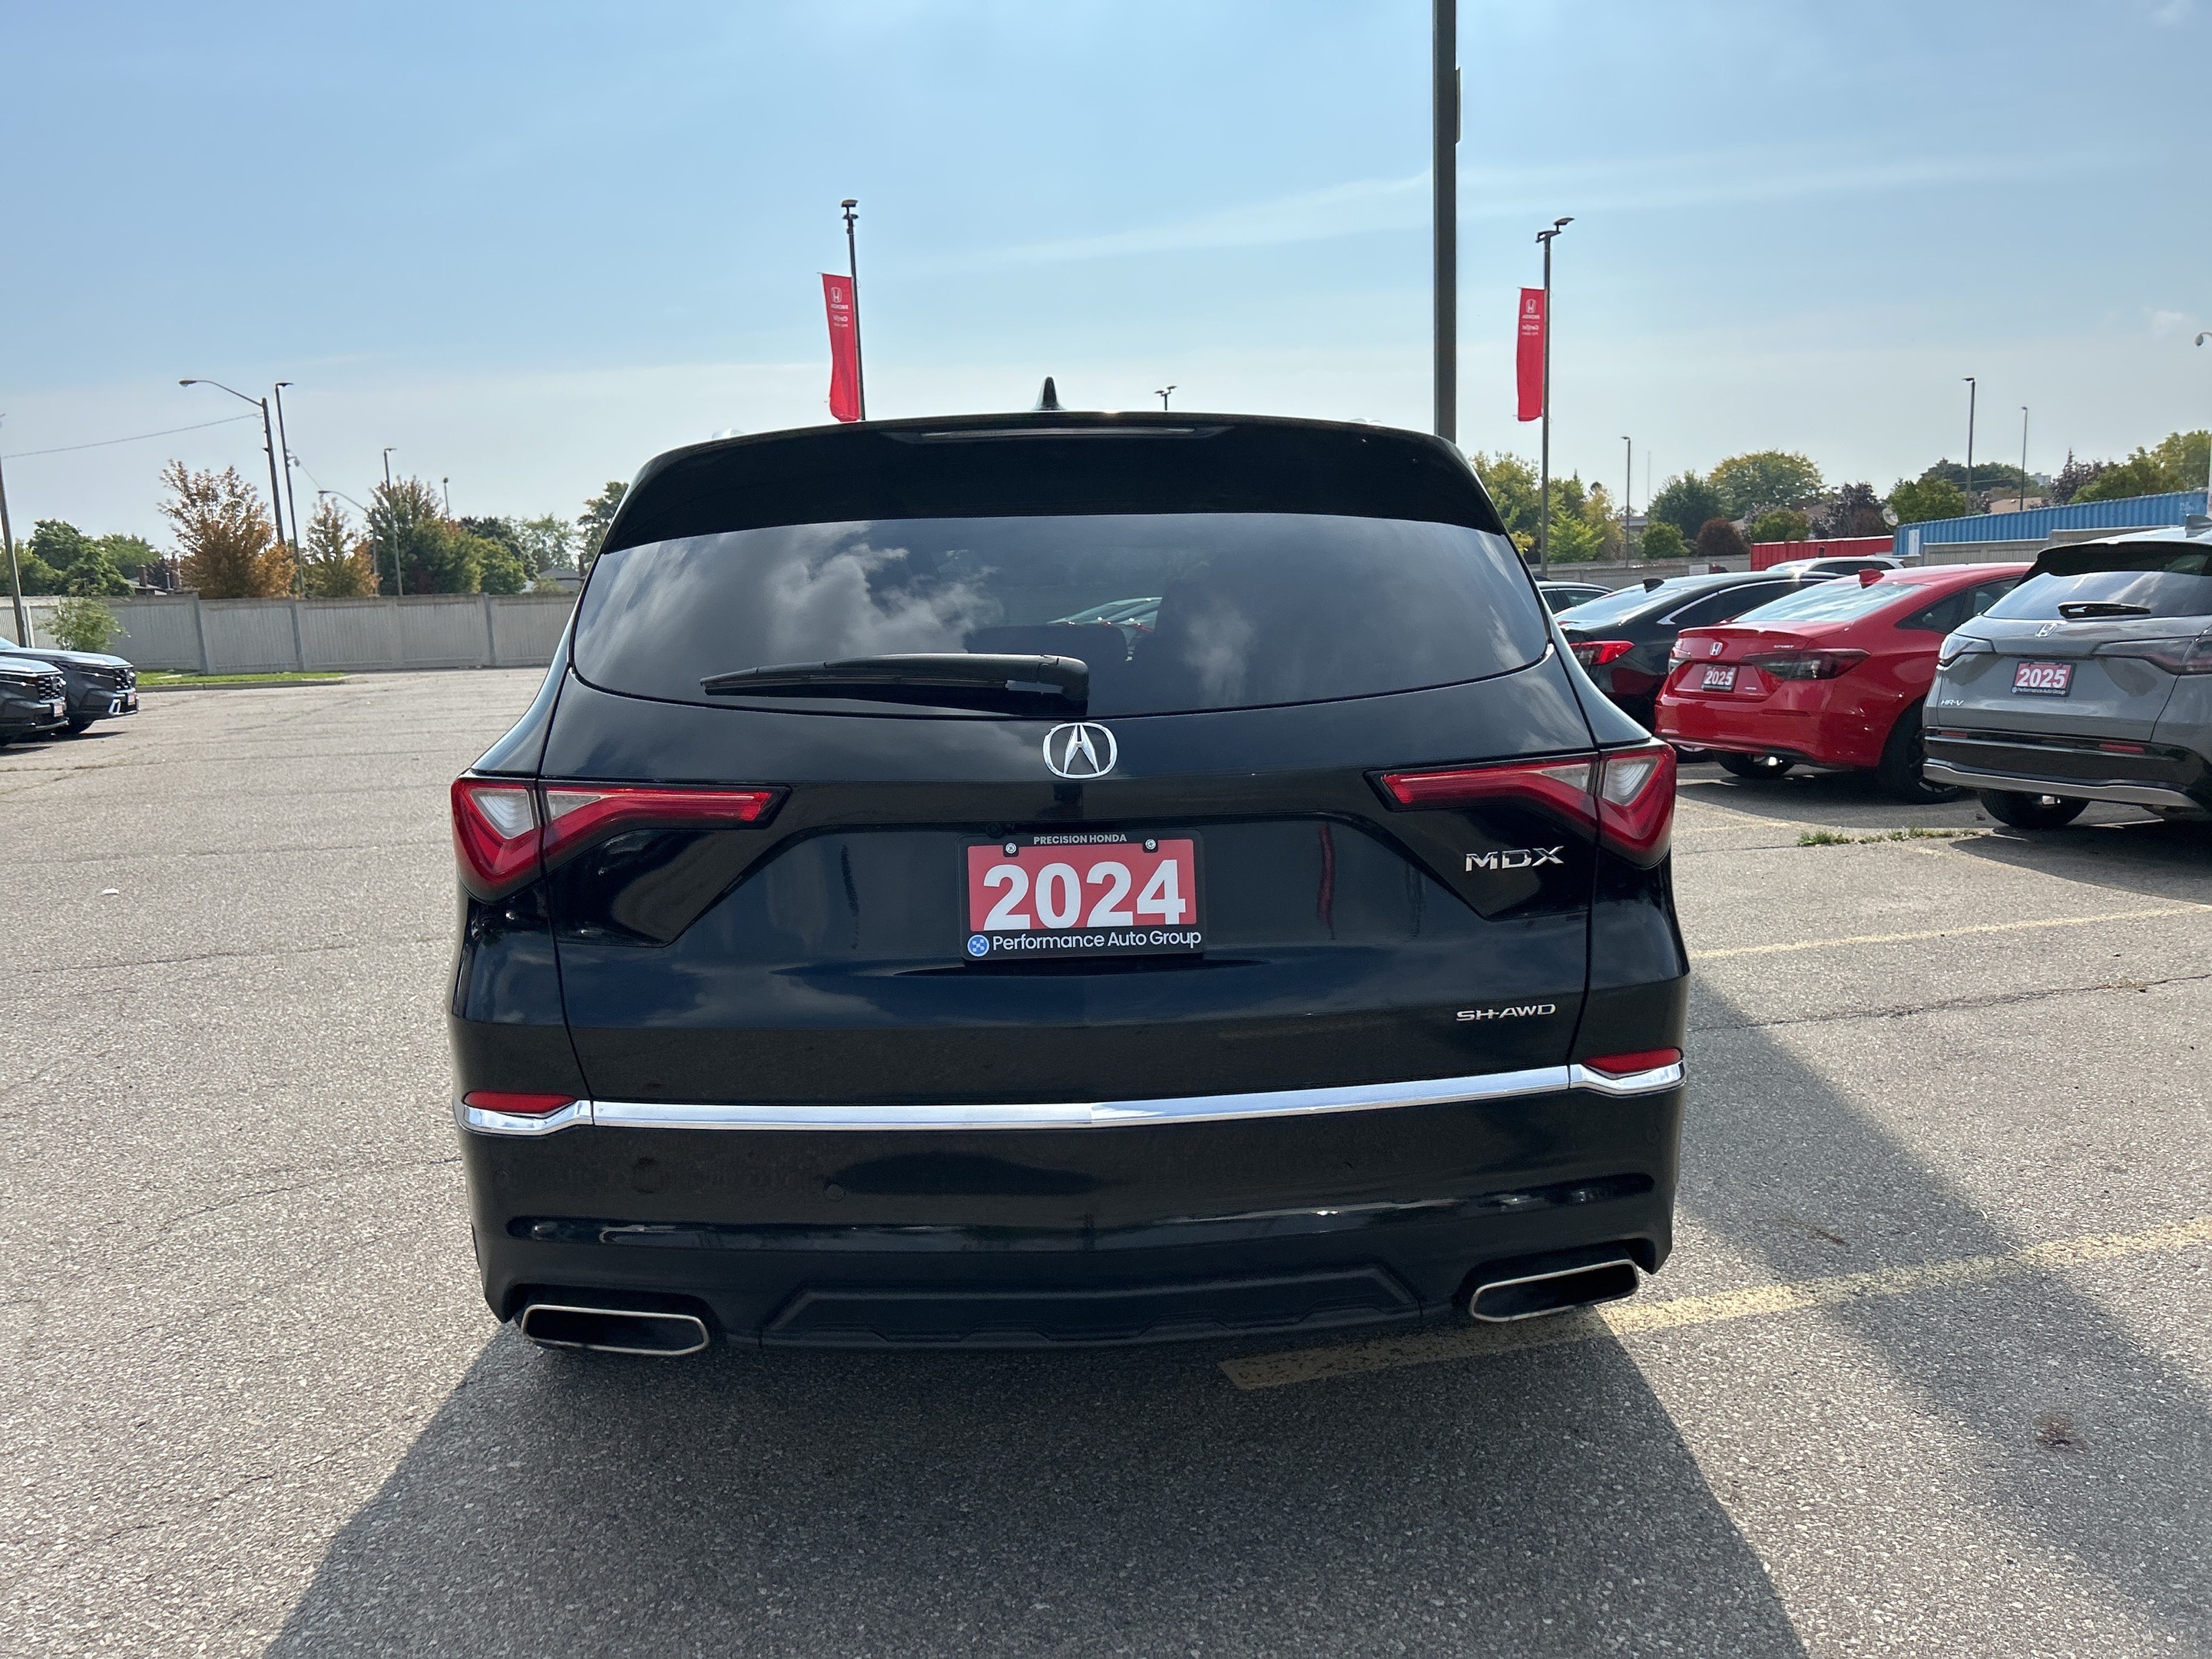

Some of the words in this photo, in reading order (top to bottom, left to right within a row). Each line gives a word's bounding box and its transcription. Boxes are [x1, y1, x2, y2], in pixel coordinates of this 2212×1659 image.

[1704, 670, 1734, 685] 2025
[2016, 667, 2066, 688] 2025
[1033, 835, 1088, 845] PRECISION
[1089, 833, 1128, 843] HONDA
[1465, 846, 1565, 872] MDX
[983, 859, 1187, 931] 2024
[992, 934, 1105, 951] Performance
[1108, 931, 1147, 947] Auto
[1149, 930, 1202, 949] Group
